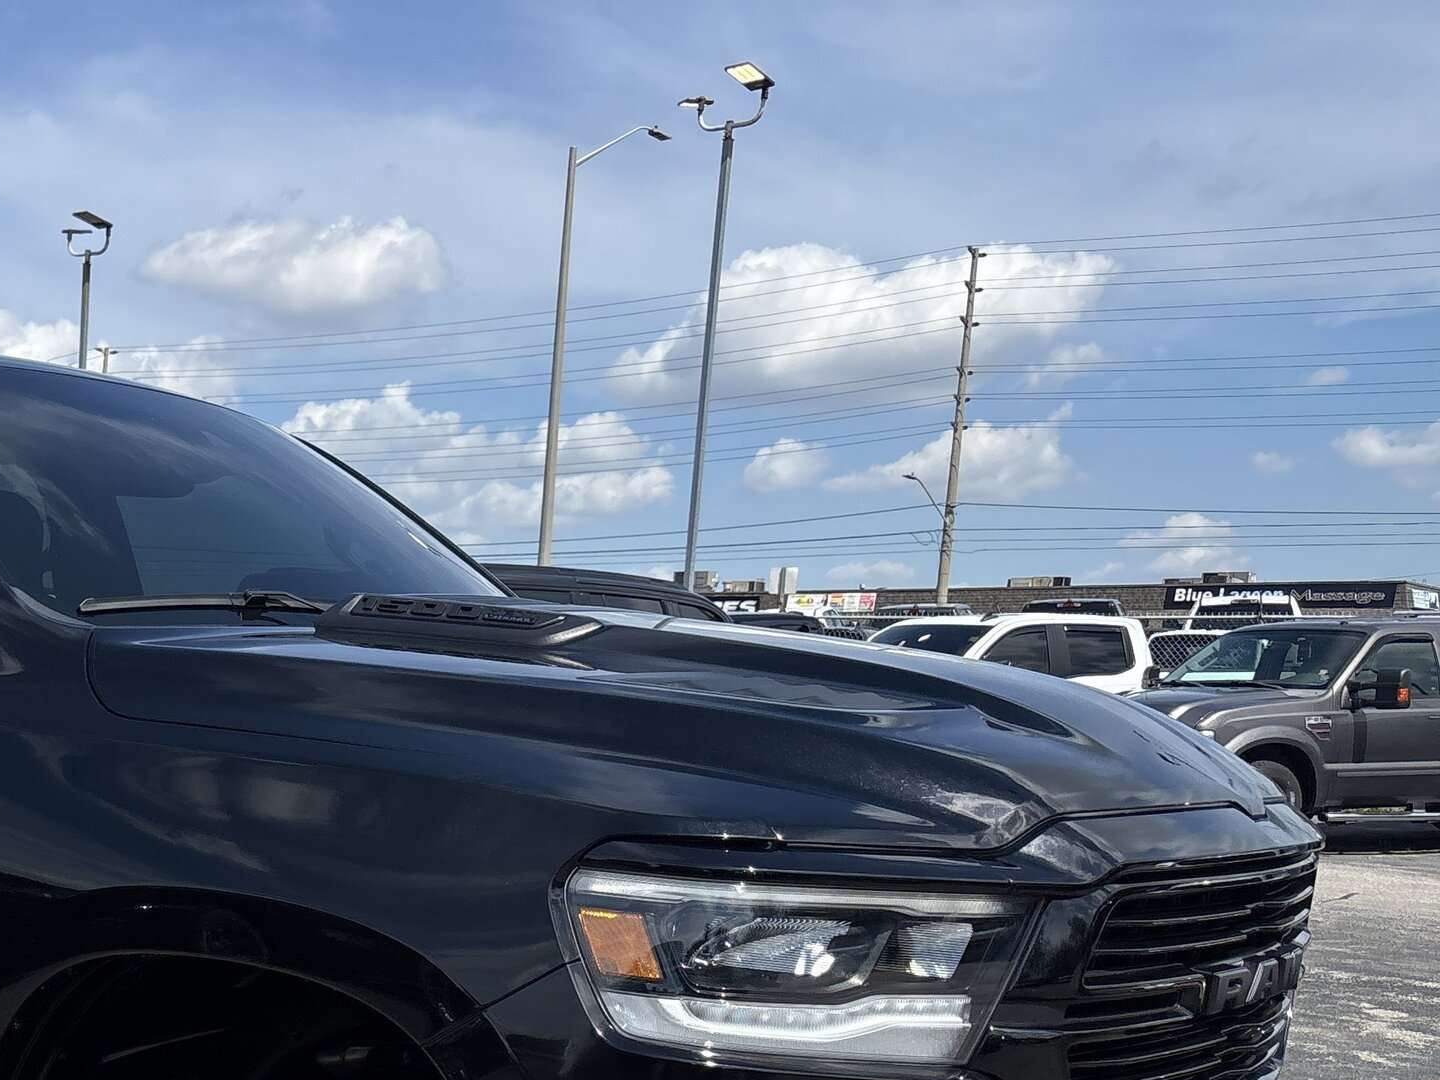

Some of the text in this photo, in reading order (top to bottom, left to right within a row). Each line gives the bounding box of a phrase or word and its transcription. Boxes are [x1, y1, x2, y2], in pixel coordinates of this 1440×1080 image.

[1174, 588, 1213, 601] Blue
[1290, 589, 1387, 604] Massage
[1208, 947, 1302, 1016] RAM
